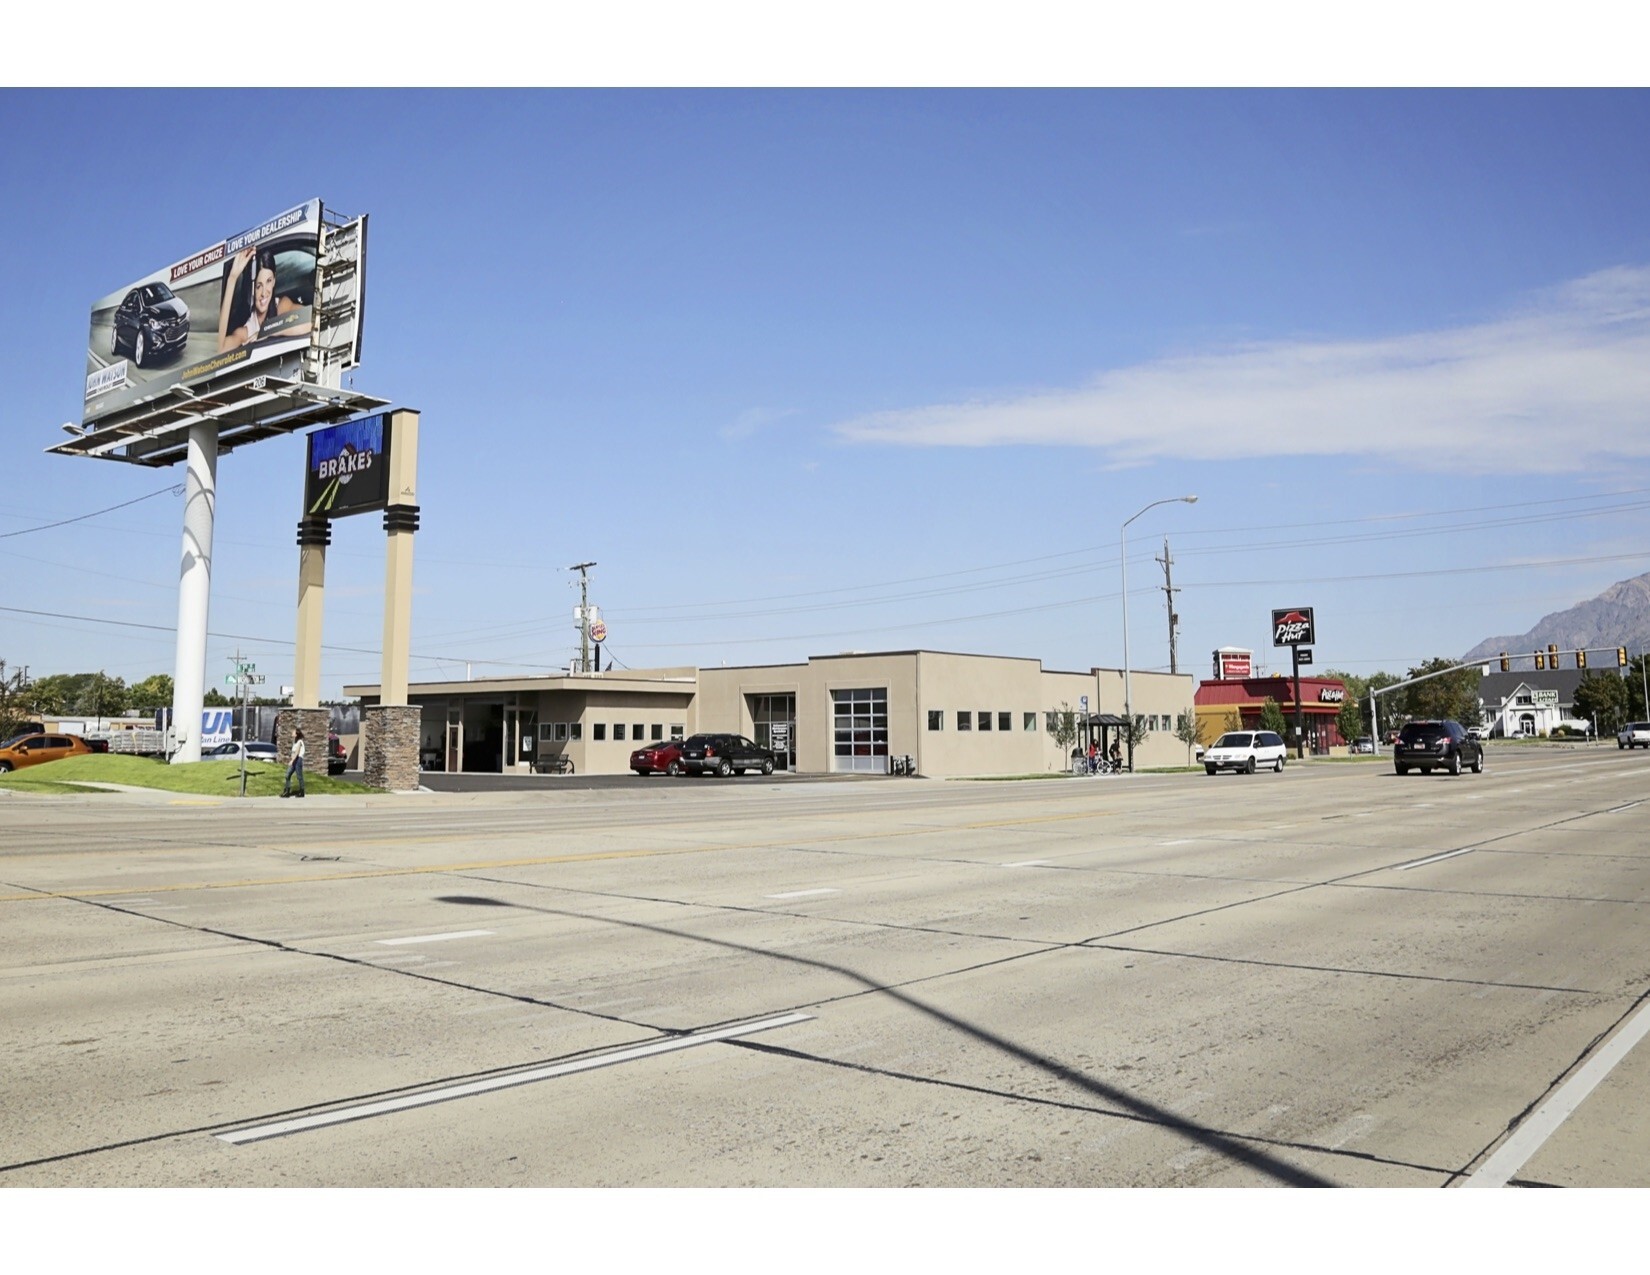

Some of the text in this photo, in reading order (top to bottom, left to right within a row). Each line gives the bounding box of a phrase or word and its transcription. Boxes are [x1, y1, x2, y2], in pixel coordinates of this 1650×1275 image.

[227, 209, 303, 253] LOVE YOUR DEALERSHIP
[173, 247, 223, 279] LOVE YOUR CRUZE
[101, 365, 126, 384] WATSON
[318, 450, 373, 480] BRAKES
[1275, 620, 1310, 639] Pizza
[1281, 630, 1307, 643] Hut
